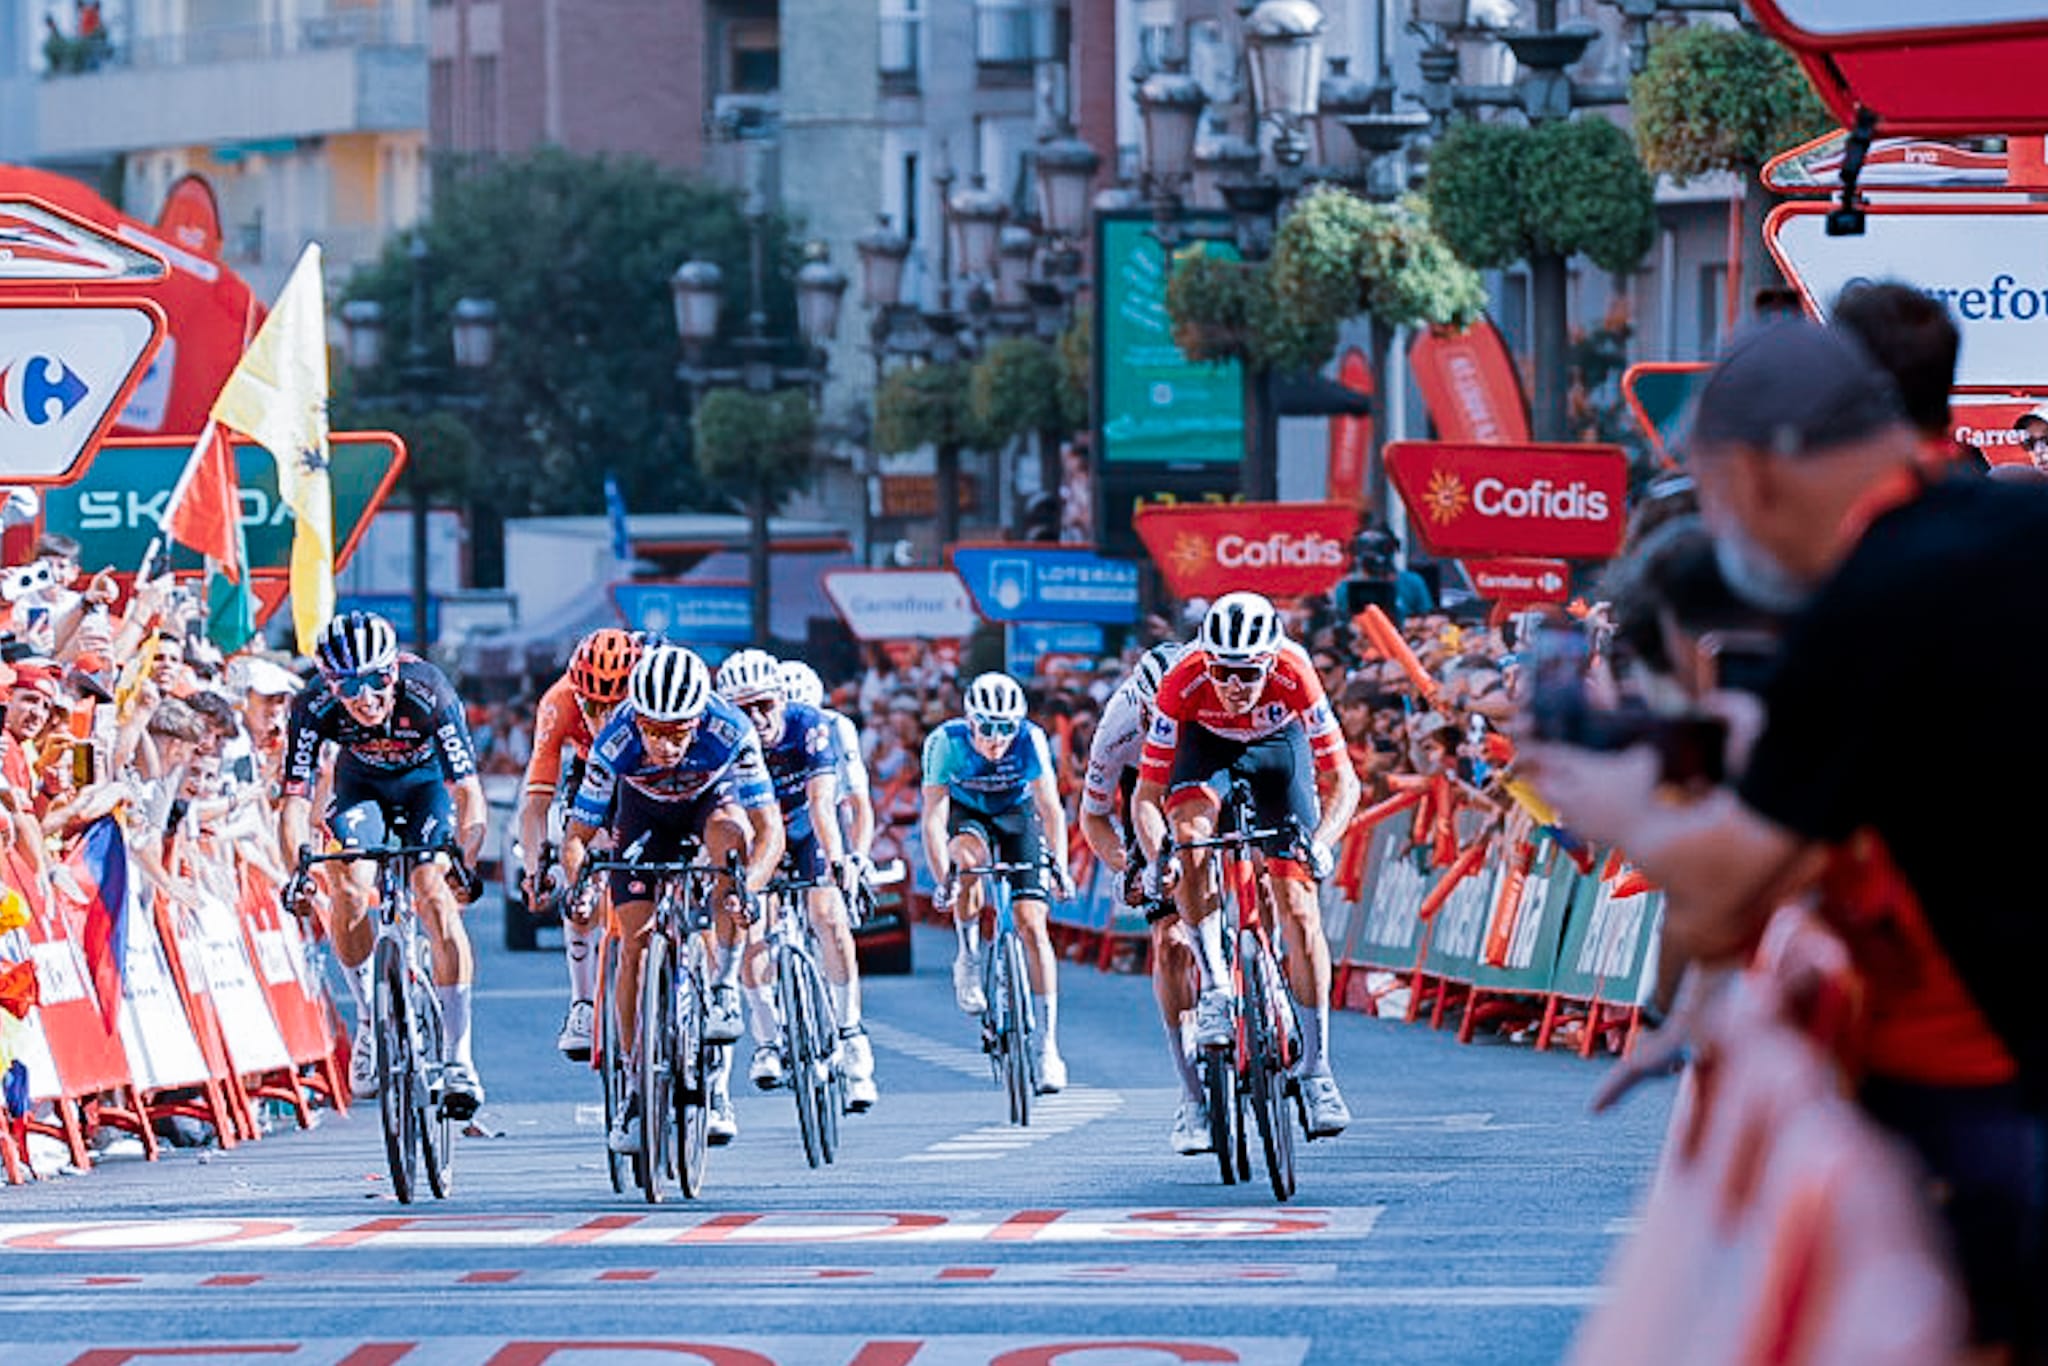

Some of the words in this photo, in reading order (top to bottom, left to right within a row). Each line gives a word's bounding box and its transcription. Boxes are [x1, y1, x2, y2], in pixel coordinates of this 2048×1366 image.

[1473, 478, 1609, 521] Cofidis
[1216, 532, 1343, 568] Cofidis
[292, 727, 319, 778] BOSS
[437, 723, 474, 773] BOSS
